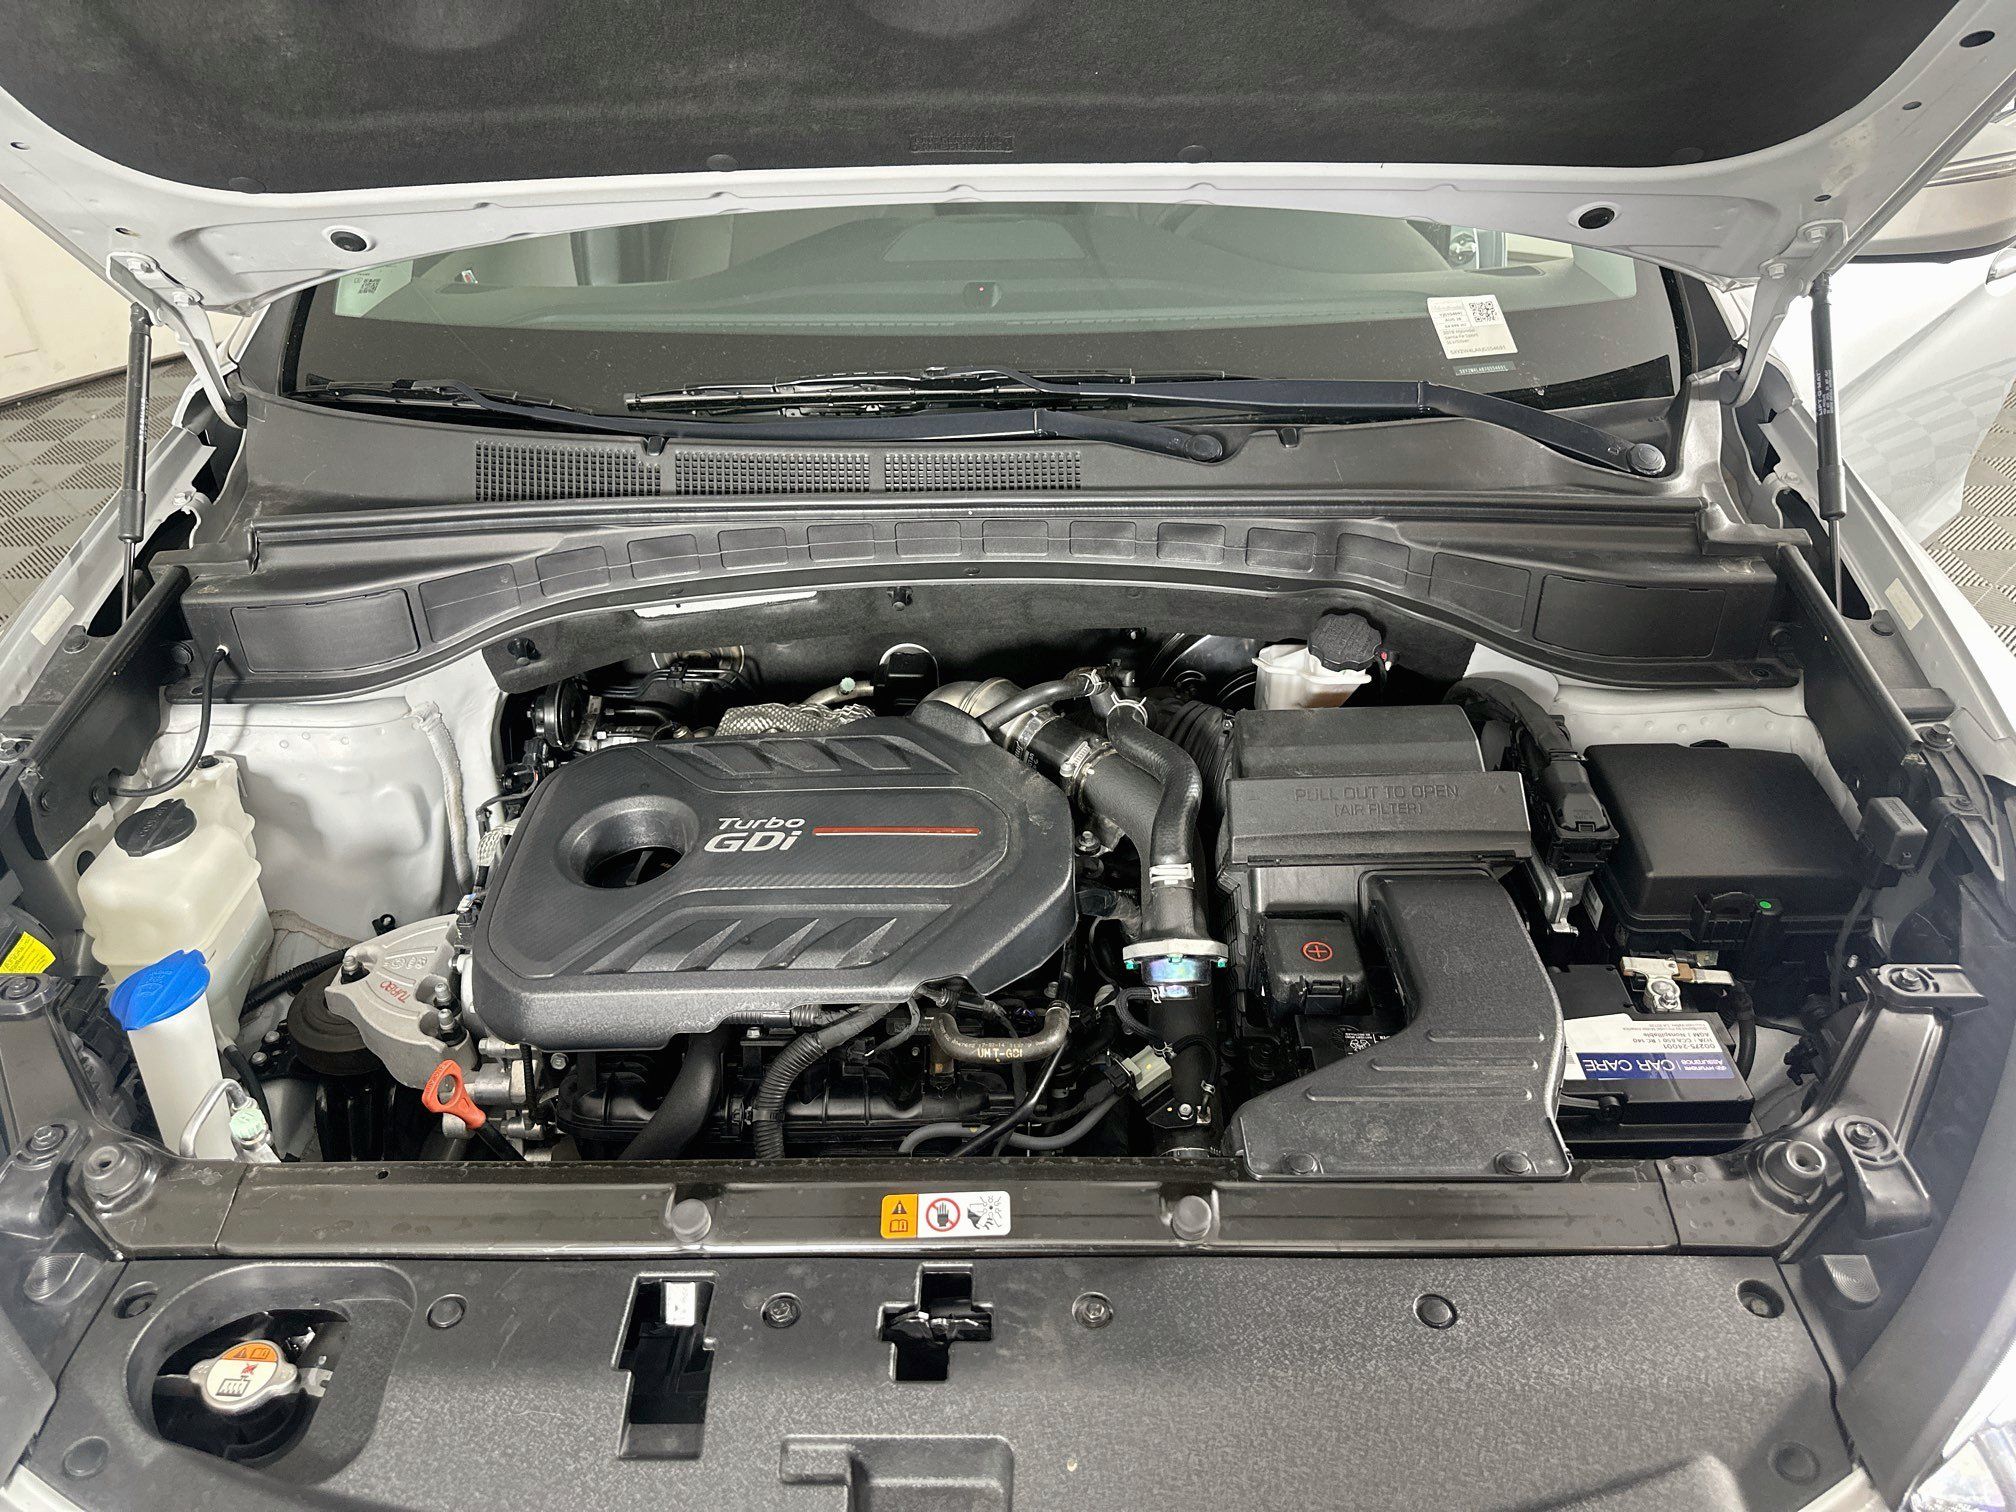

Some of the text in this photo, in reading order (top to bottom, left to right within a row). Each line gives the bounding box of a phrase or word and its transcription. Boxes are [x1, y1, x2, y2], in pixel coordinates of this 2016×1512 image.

[1294, 784, 1459, 802] PULL OUT TO OPEN
[718, 816, 806, 830] Turbo
[704, 830, 803, 852] GDi
[1582, 1059, 1633, 1071] CARE
[1635, 1059, 1676, 1071] CAR
